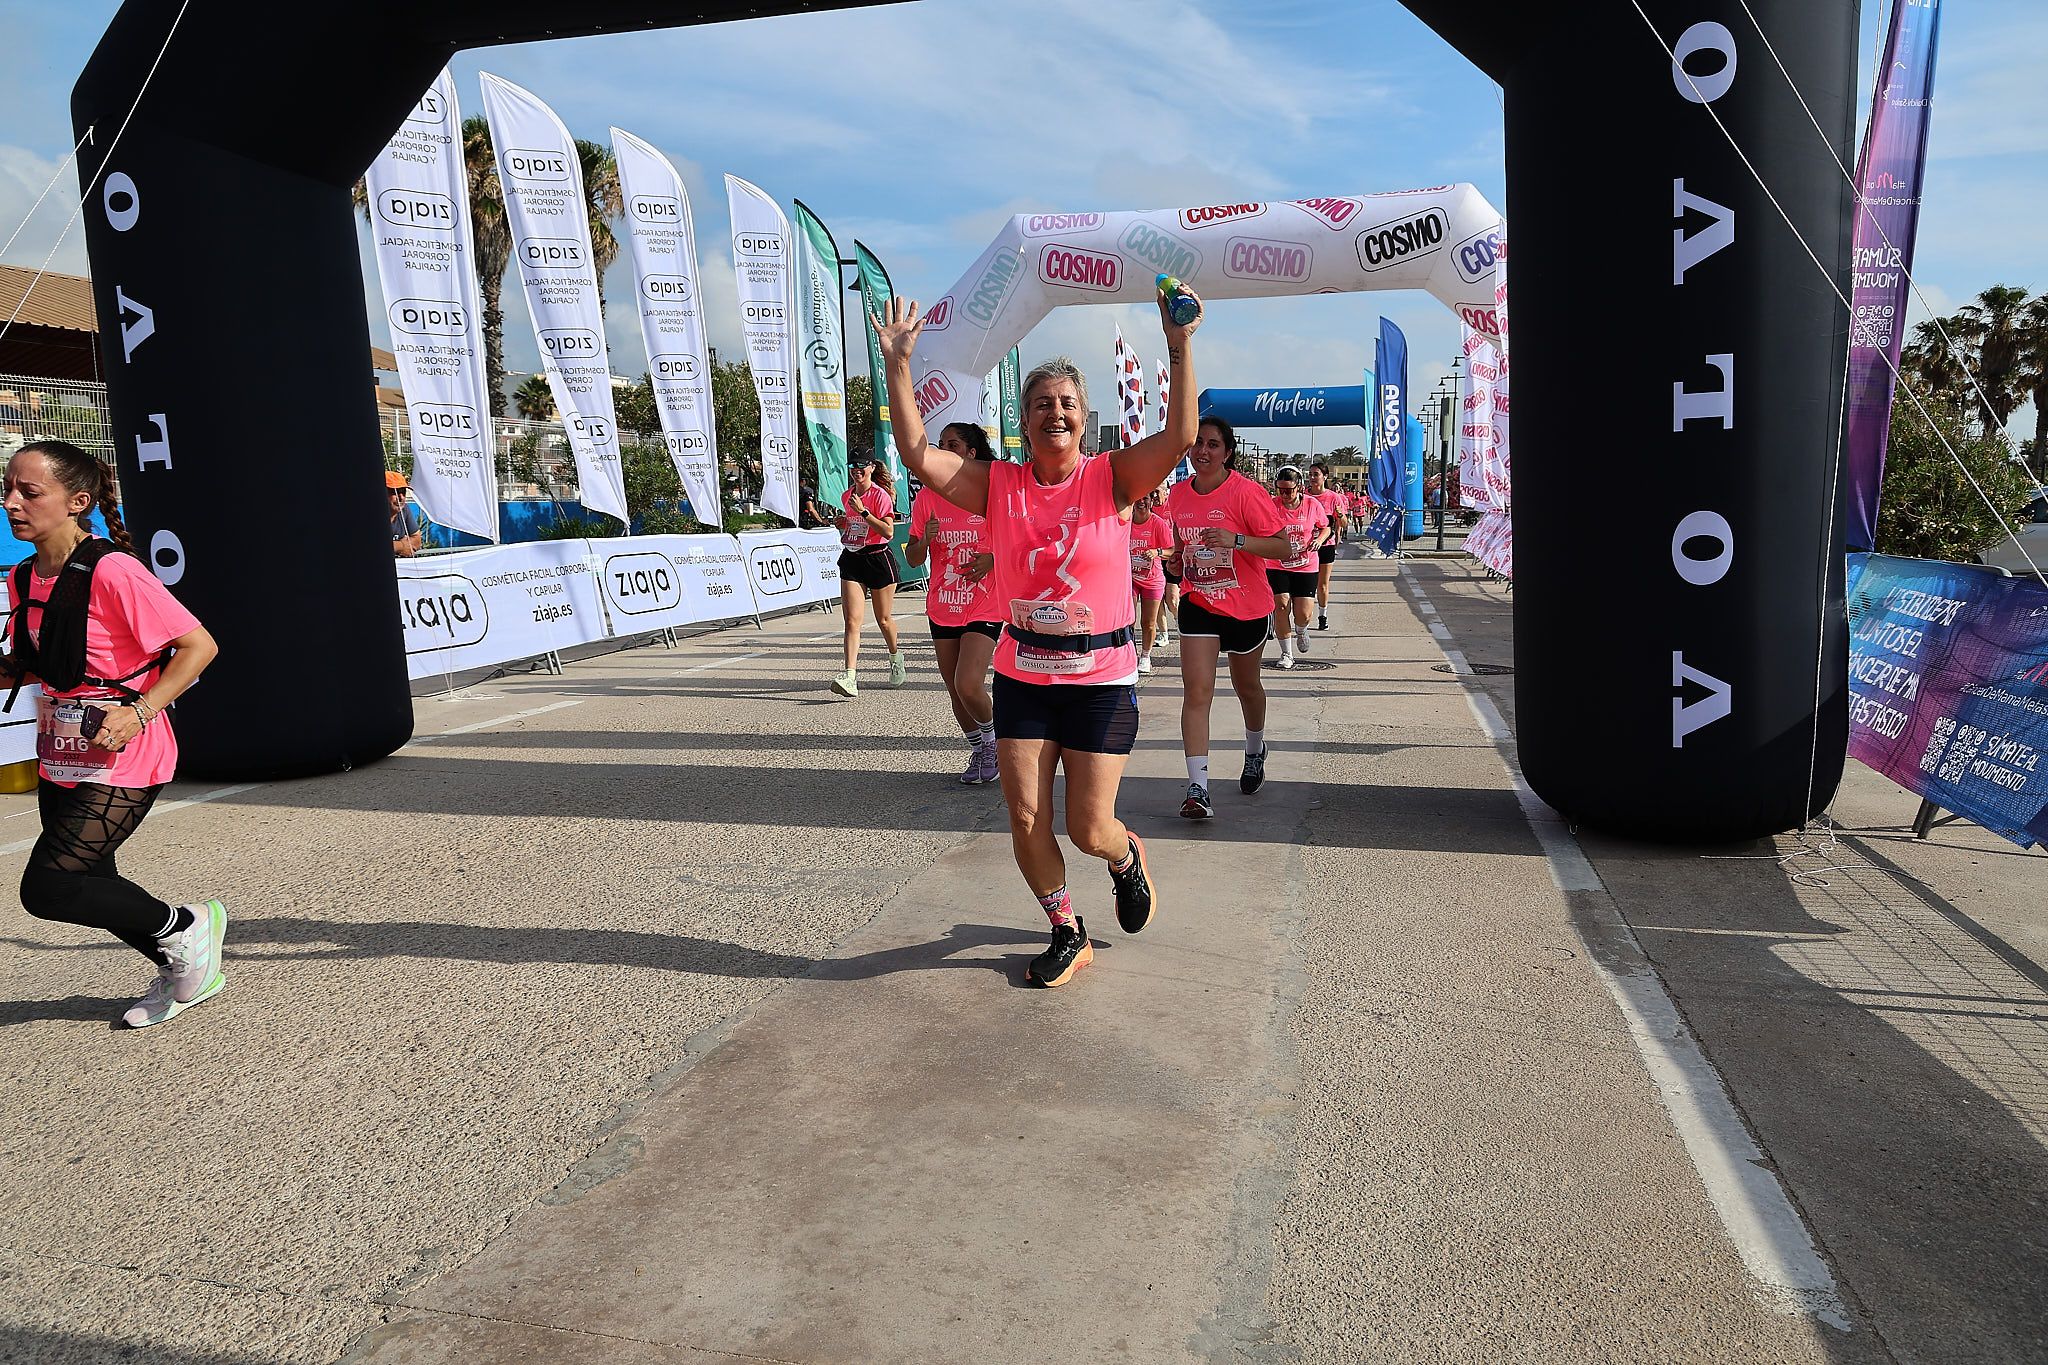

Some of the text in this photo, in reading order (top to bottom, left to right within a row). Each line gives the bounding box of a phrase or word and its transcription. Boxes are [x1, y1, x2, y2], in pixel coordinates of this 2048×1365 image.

[1029, 212, 1099, 231] COSMO
[1187, 203, 1258, 223] COSMO
[1126, 224, 1195, 278] COSMO
[1365, 213, 1442, 264] COSMO
[1046, 250, 1116, 287] COSMO
[1231, 242, 1305, 278] COSMO
[967, 253, 1020, 321] COSMO
[1672, 21, 1737, 748] VOLVO
[1255, 391, 1325, 421] Marlene
[936, 530, 978, 543] CARRERA
[482, 572, 528, 588] COSMÉTICA
[757, 556, 795, 586] ziaja
[1198, 567, 1217, 576] 016
[526, 583, 564, 598] Y CAPILAR
[615, 567, 670, 603] ziaja
[706, 583, 733, 598] ziaja.es
[939, 590, 974, 604] MUJER
[401, 592, 473, 638] iaja
[532, 602, 573, 623] ziaja.es
[1022, 661, 1045, 669] OYSHO
[54, 737, 89, 751] 016
[1969, 758, 2027, 791] MOVIMIENTO
